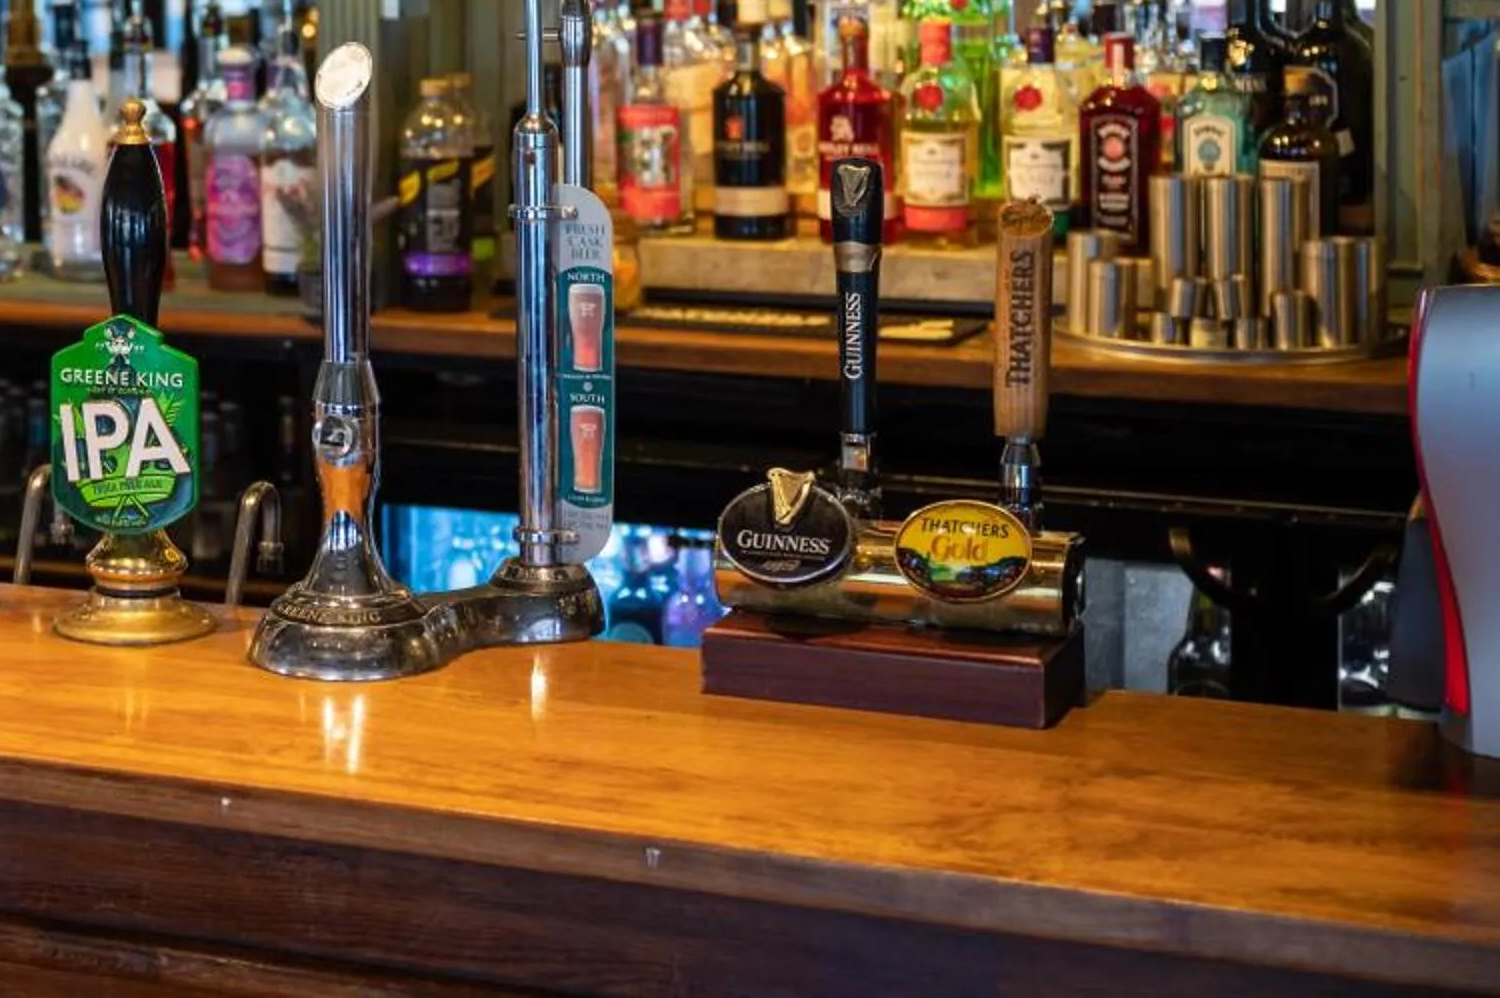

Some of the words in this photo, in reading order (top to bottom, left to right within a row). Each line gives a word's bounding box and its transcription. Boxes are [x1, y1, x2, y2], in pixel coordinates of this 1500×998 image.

[566, 272, 606, 283] NORTH
[1006, 249, 1036, 388] THATCHERS
[843, 291, 863, 380] GUINNESS
[59, 367, 130, 387] GREENE
[135, 370, 184, 388] KING
[568, 393, 606, 404] SOUTH
[59, 397, 192, 482] IPA
[920, 517, 1010, 539] THATCHERS
[737, 529, 833, 555] GUINNESS
[930, 534, 988, 562] Gold
